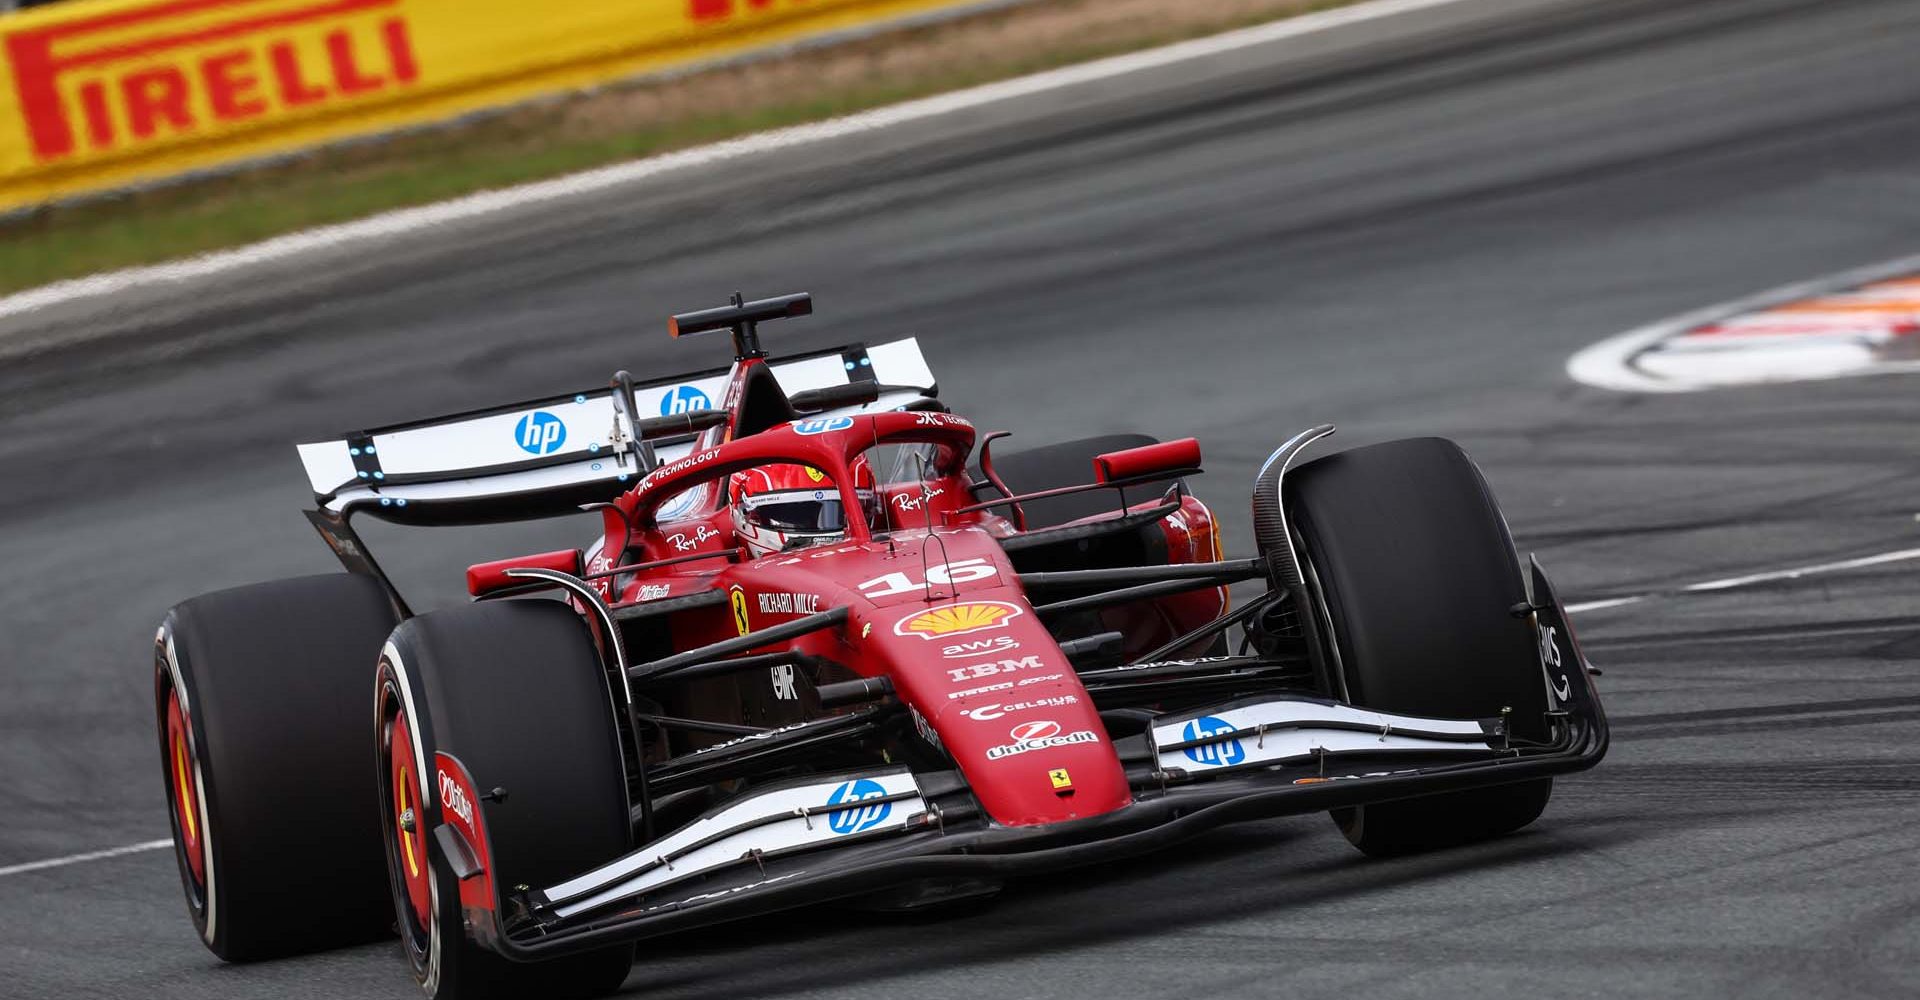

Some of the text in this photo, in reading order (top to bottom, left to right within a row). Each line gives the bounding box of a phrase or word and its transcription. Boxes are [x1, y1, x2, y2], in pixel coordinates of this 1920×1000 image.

[5, 0, 419, 163] PIRELLI
[522, 412, 560, 454] hp
[655, 449, 720, 480] TECHNOLOGY
[667, 525, 720, 551] Ray-Ban
[857, 558, 997, 599] 16
[758, 592, 820, 615] RICHARD MILLE
[942, 636, 1014, 655] aws
[946, 655, 1044, 682] IBM
[1003, 695, 1076, 712] CELSIUS
[986, 731, 1098, 760] UniCredit
[1191, 718, 1236, 766] hp
[834, 780, 884, 834] hp
